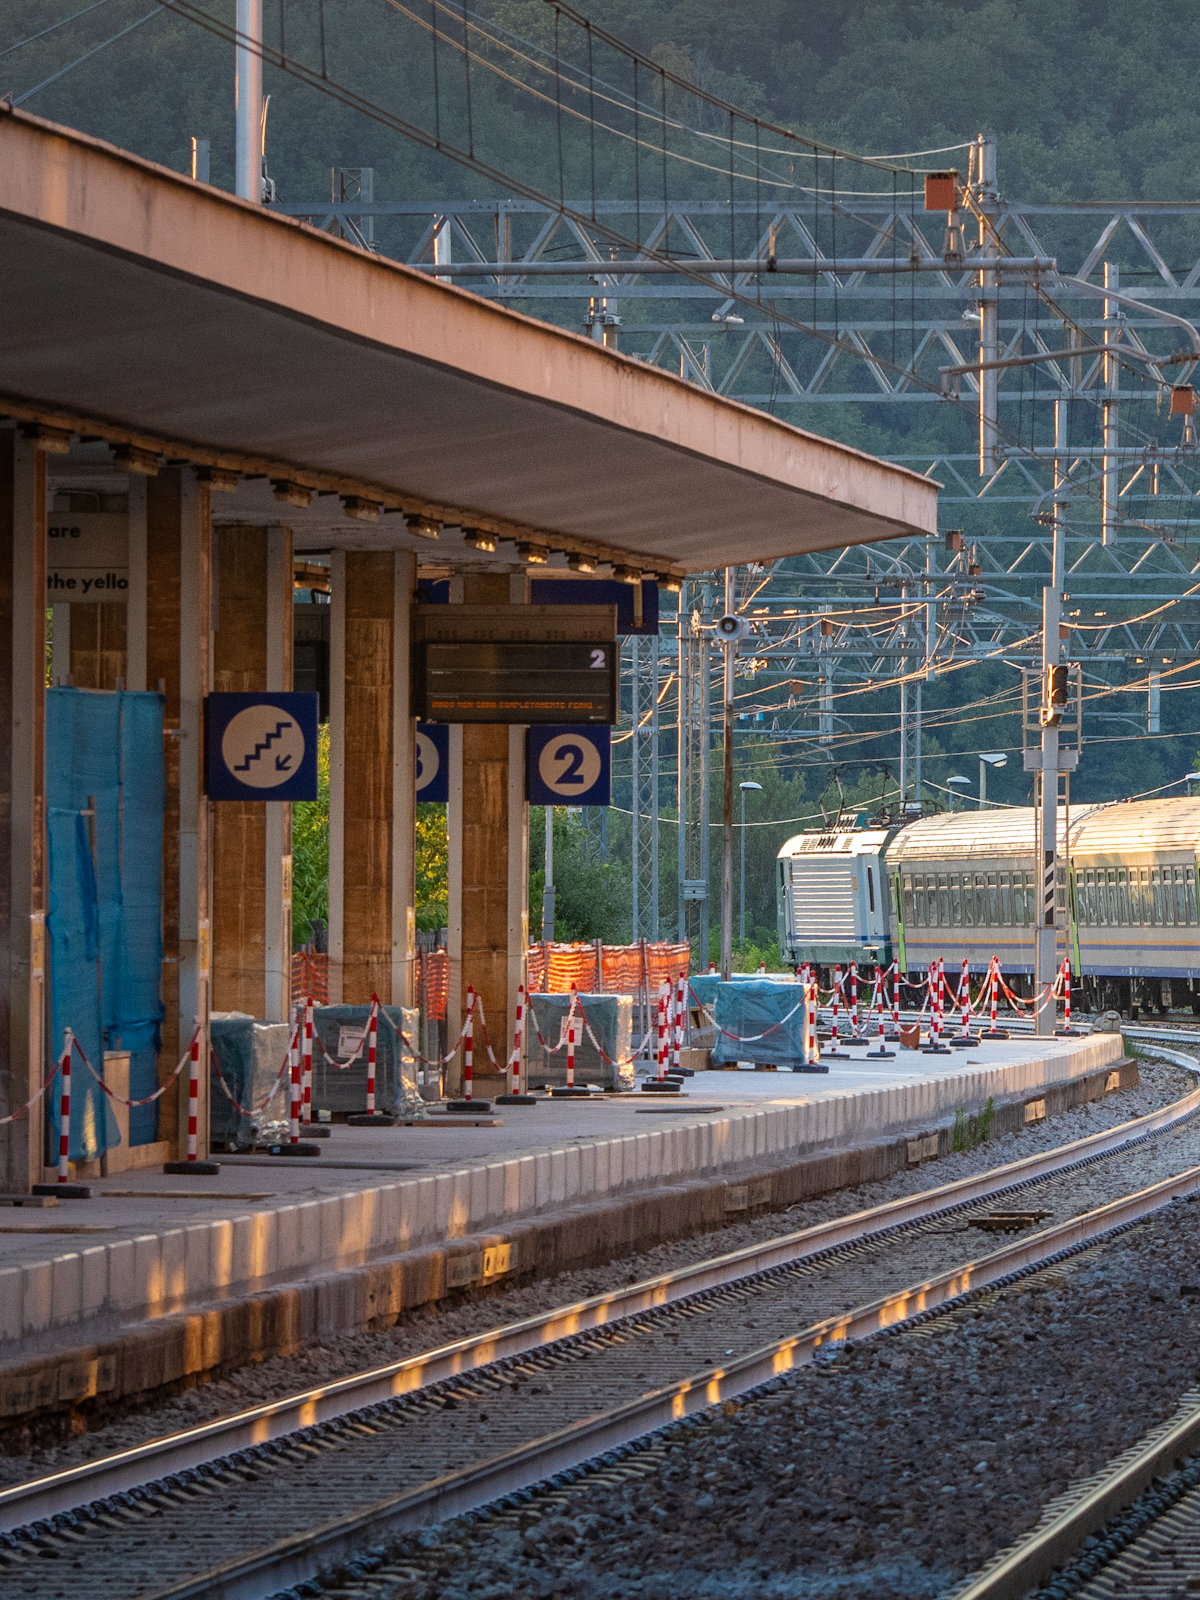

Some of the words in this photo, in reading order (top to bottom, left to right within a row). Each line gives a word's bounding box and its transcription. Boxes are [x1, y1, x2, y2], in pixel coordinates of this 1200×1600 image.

[47, 573, 77, 589] the
[81, 573, 129, 594] yello
[589, 649, 606, 668] 2
[553, 743, 585, 785] 2
